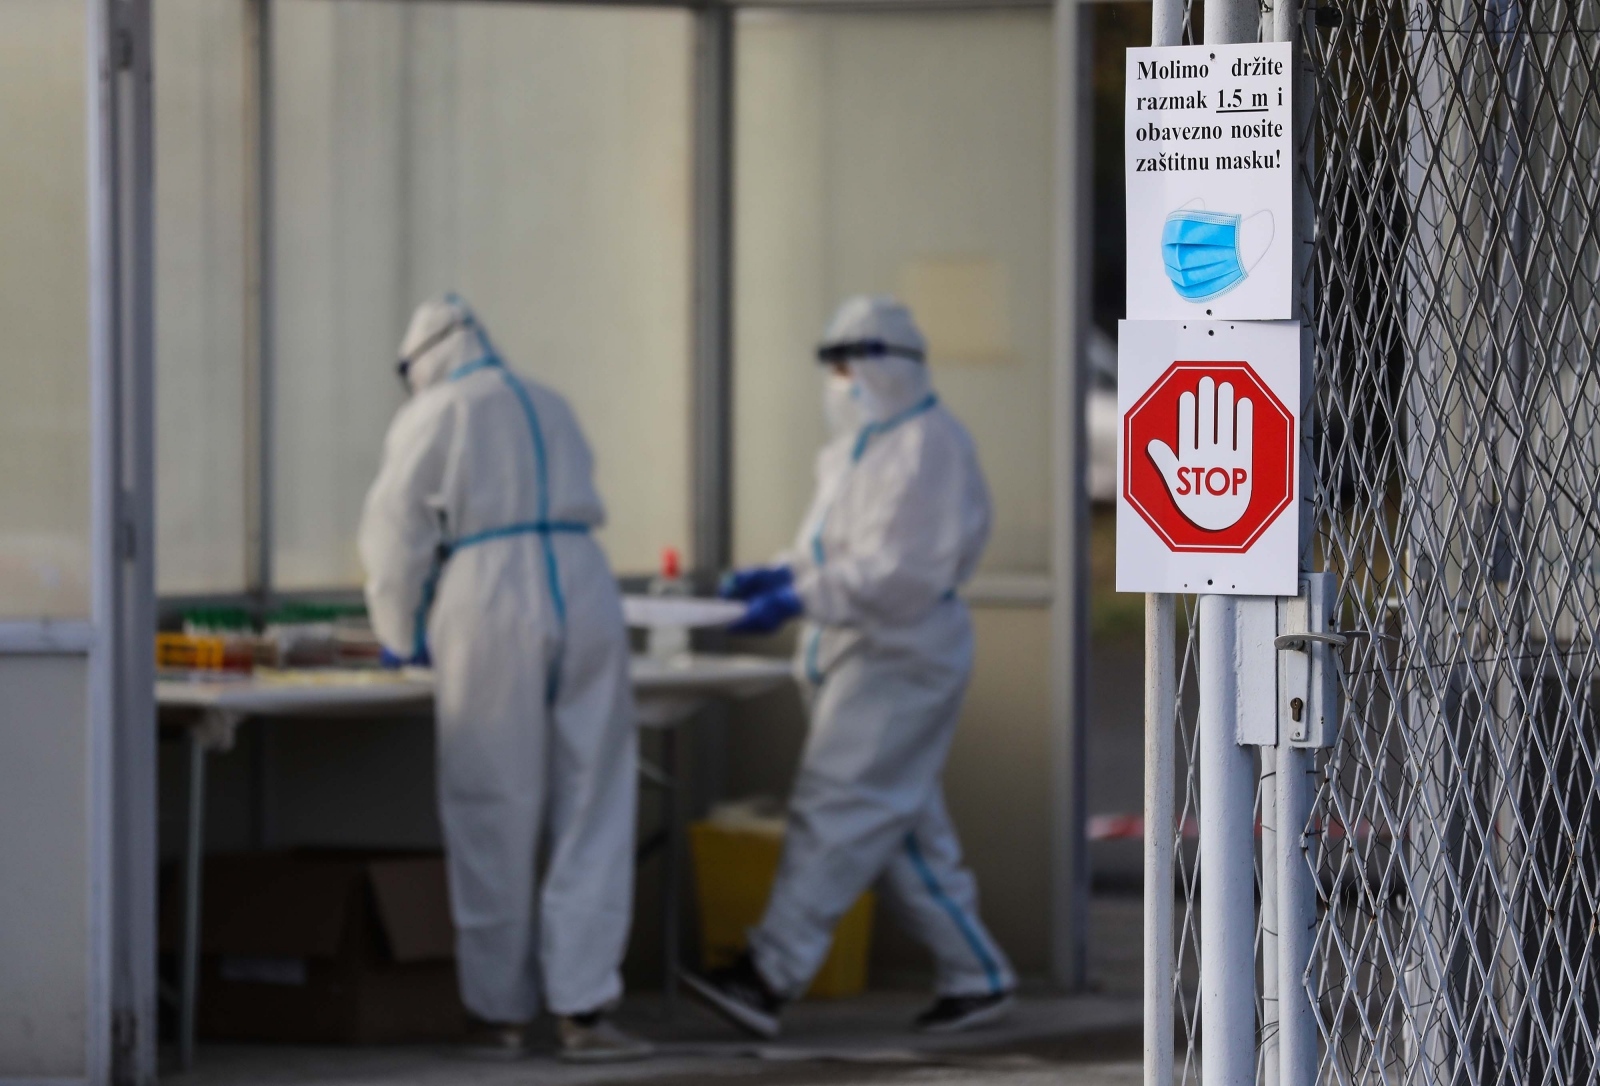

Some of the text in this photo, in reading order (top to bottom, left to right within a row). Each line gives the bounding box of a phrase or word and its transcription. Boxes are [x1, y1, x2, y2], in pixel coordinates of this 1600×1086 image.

[1137, 56, 1283, 80] Molimo držite
[1137, 87, 1283, 110] razmak 1.5 m i
[1136, 119, 1283, 141] obavezno nosite
[1136, 149, 1281, 172] zaštitnu masku!
[1176, 467, 1247, 496] STOP
